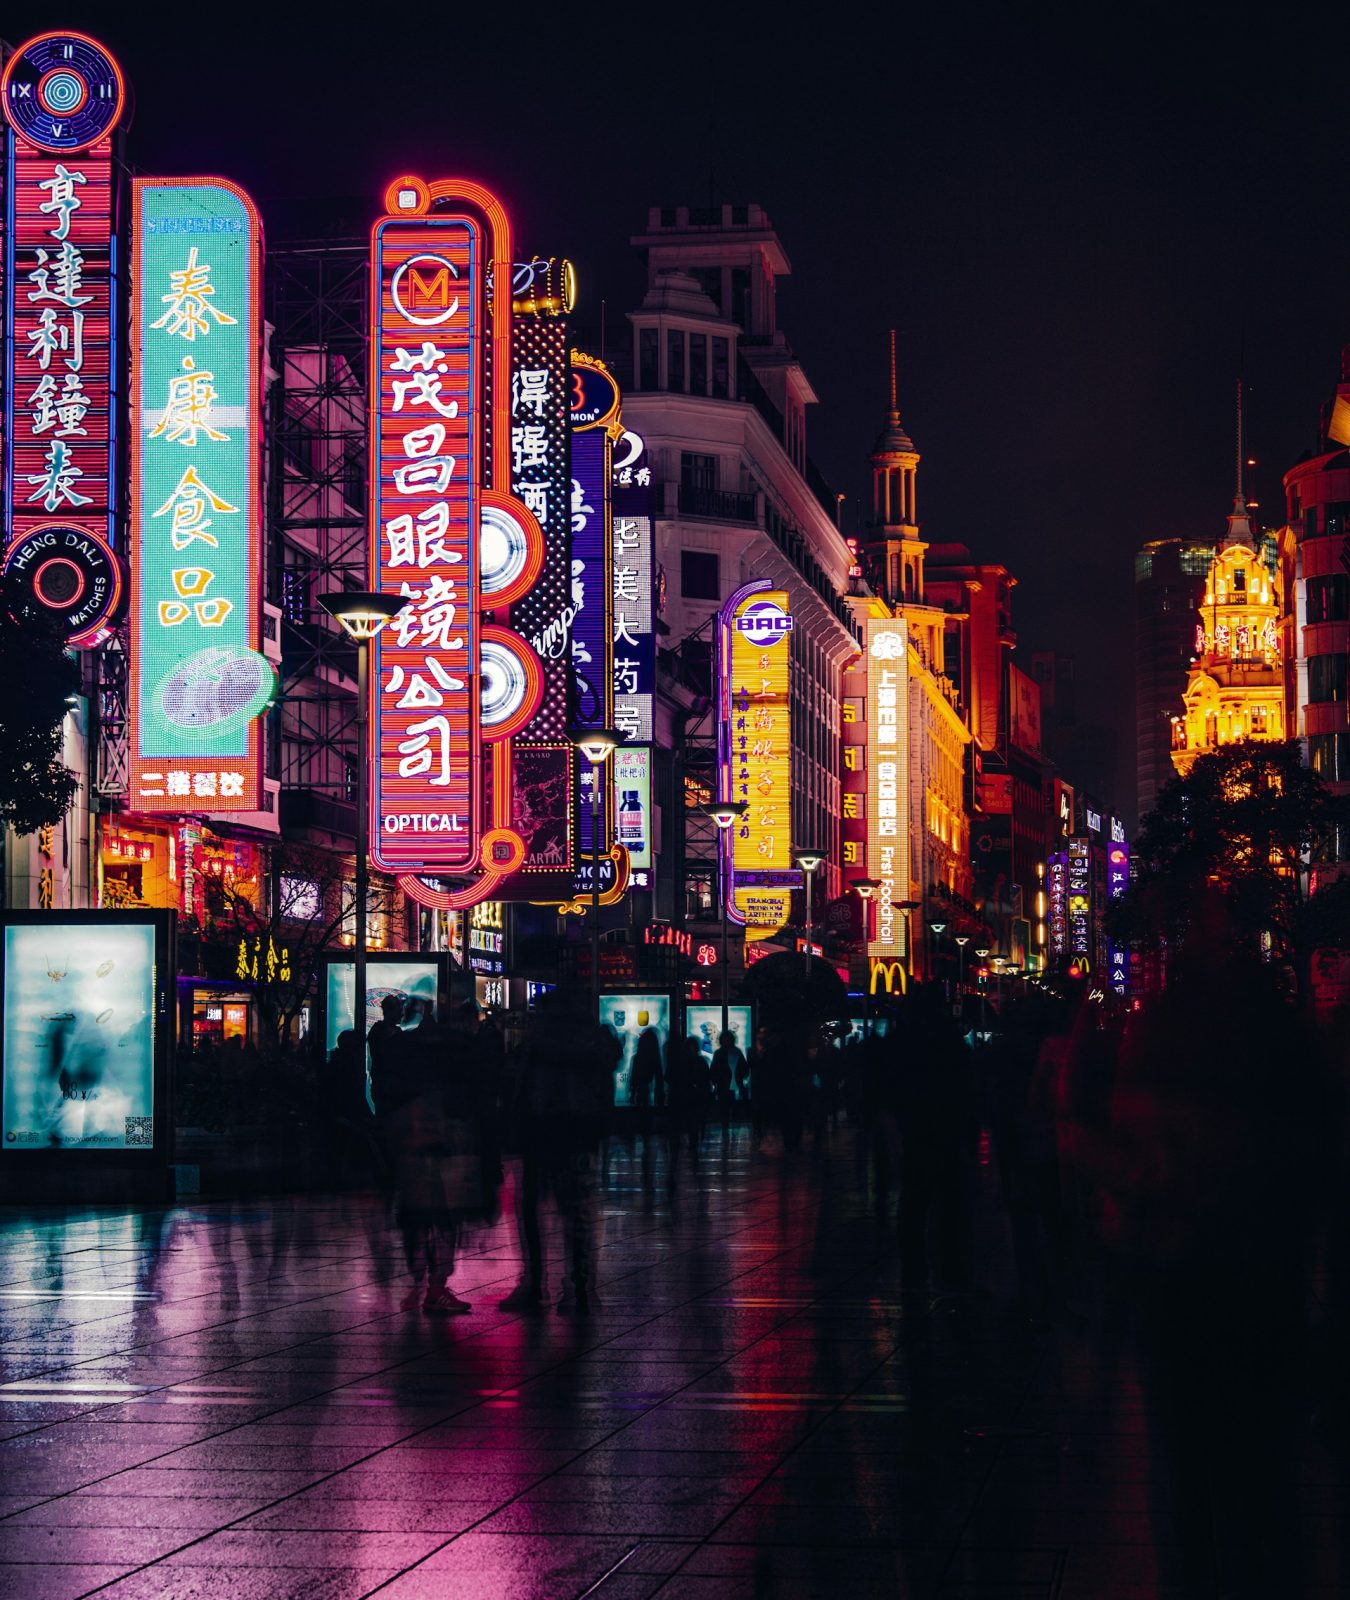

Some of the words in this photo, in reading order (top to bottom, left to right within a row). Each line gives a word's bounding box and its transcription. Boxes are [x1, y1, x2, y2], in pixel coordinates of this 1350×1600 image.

[148, 246, 241, 628] 泰康食品
[13, 533, 57, 570] HENG
[65, 533, 103, 567] DALI
[384, 341, 465, 788] 茂昌眼镜公司
[68, 576, 106, 626] WATCHES
[736, 617, 793, 632] BAC
[384, 813, 464, 834] OPTICAL
[880, 846, 895, 875] First
[880, 879, 895, 944] Foodhall
